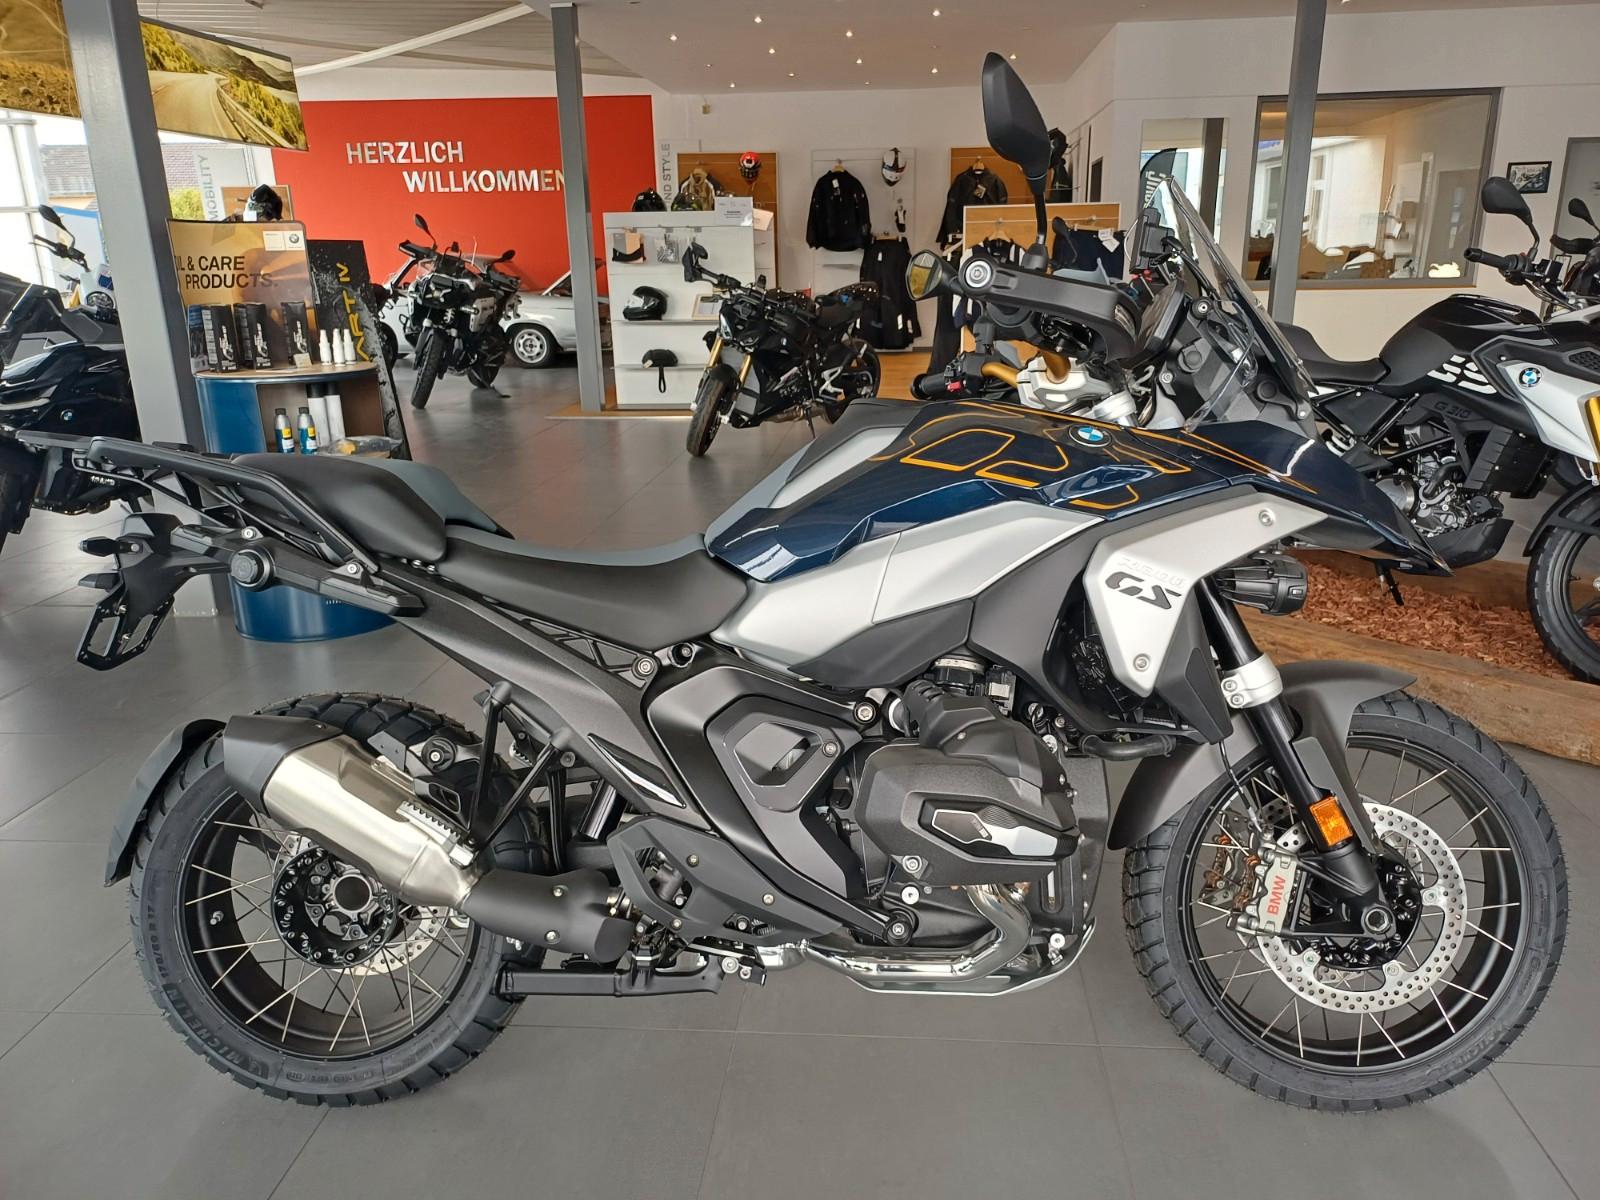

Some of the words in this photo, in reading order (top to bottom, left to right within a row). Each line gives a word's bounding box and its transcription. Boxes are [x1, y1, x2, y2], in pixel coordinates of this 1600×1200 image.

[346, 141, 464, 164] HERZLICH
[661, 144, 672, 182] STYLE
[402, 169, 566, 193] WILLKOMMEN
[187, 255, 195, 271] &
[198, 255, 245, 271] CARE
[185, 273, 279, 290] PRODUCTS.
[1105, 571, 1183, 610] GS
[1266, 875, 1287, 916] BMW
[167, 987, 244, 1066] MICHELIN
